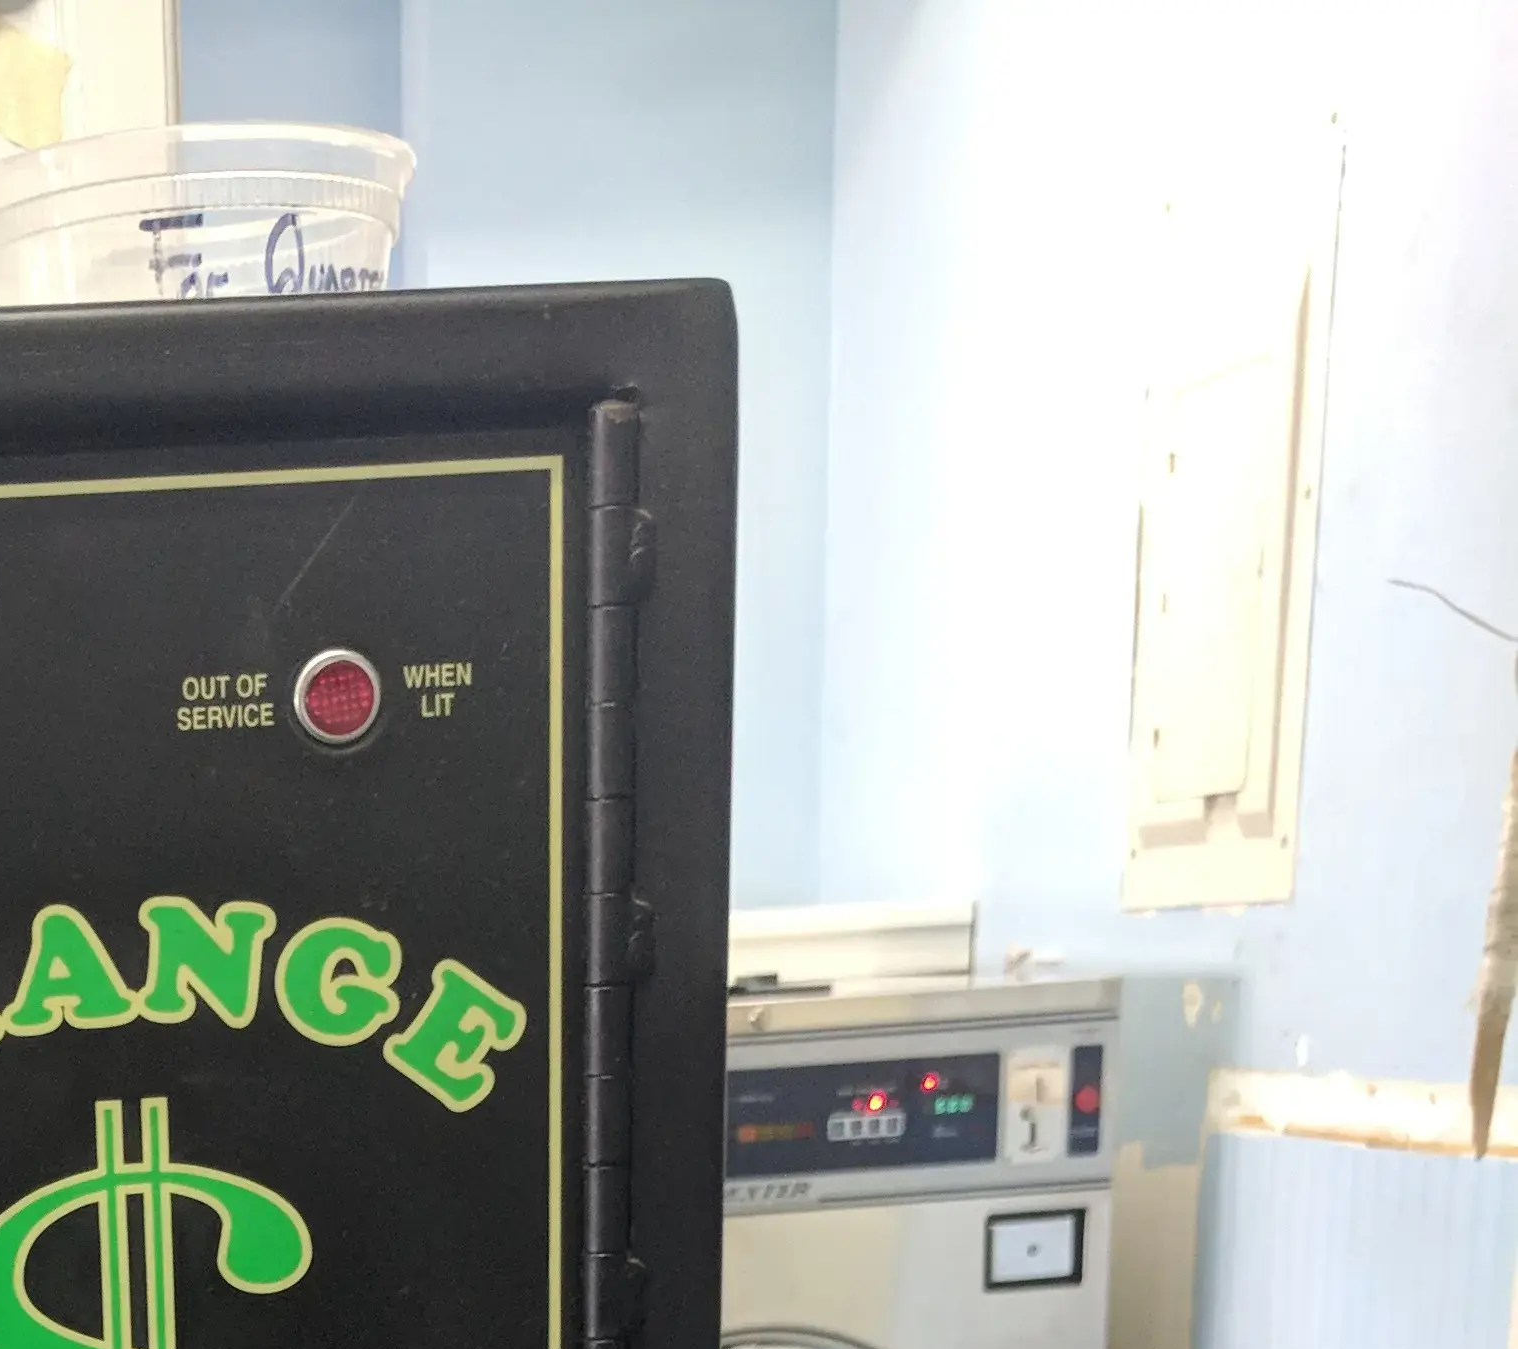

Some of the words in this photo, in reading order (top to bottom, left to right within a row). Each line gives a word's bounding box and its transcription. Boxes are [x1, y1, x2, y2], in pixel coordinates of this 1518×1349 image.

[182, 676, 229, 701] OUT
[236, 673, 269, 698] OF
[403, 662, 473, 689] WHEN
[177, 703, 275, 731] SERVICE
[421, 693, 456, 718] LIT
